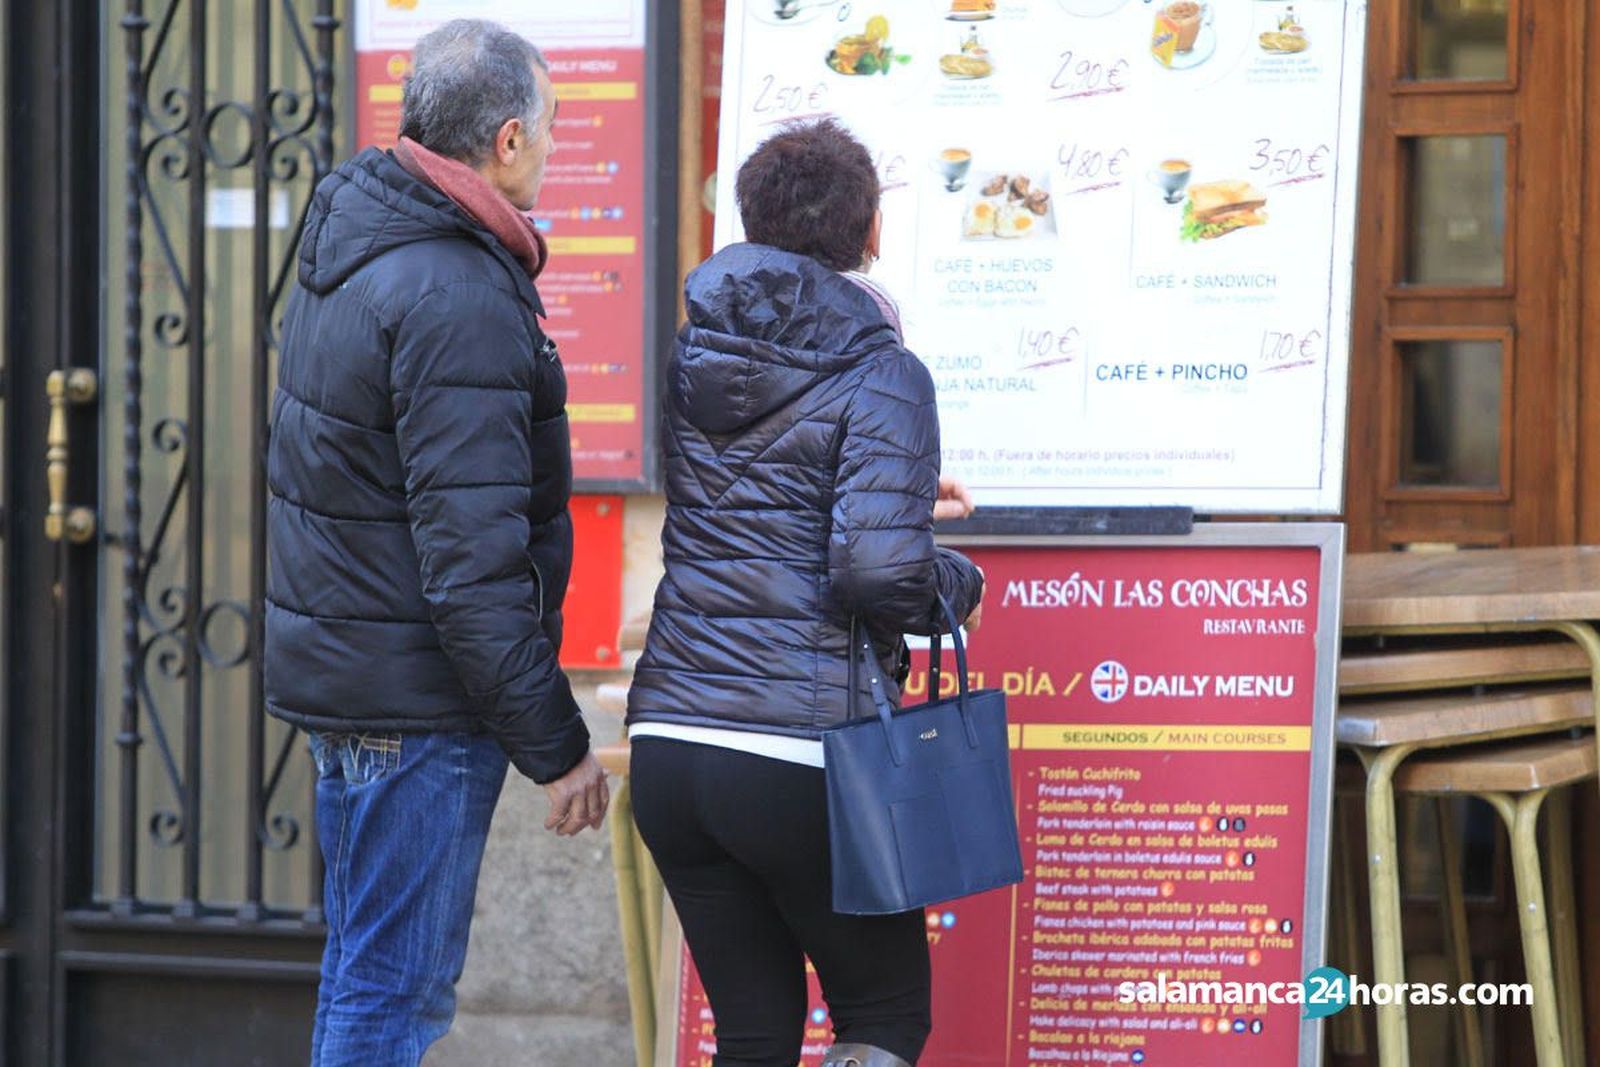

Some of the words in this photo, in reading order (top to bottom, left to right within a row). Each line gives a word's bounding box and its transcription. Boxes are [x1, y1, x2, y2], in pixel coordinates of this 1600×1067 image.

[990, 257, 1053, 273] HUEVOS
[947, 279, 981, 293] CON
[984, 279, 1039, 293] BACON
[1193, 273, 1277, 288] SANDWICH
[935, 355, 982, 370] ZUMO
[1096, 361, 1148, 381] CAFÉ
[1172, 363, 1249, 381] PINCHO
[964, 377, 1040, 392] NATURAL
[1036, 449, 1051, 461] de
[1055, 449, 1101, 461] horario
[1104, 450, 1150, 463] precios
[1154, 449, 1236, 464] individuales)
[1001, 572, 1105, 607] MESÓN
[1113, 579, 1164, 607] LAS
[1170, 579, 1309, 608] CONCHAS
[1002, 665, 1057, 697] DÍA
[1062, 672, 1084, 696] /
[1133, 676, 1211, 697] DAILY
[1215, 675, 1294, 697] MENU
[1063, 731, 1148, 744] SEGUNDOS
[1168, 731, 1208, 744] MAIN
[1213, 732, 1287, 745] COURSES
[1038, 783, 1066, 796] Fried
[1091, 800, 1107, 813] de
[1111, 801, 1146, 814] Cerdo
[1149, 803, 1170, 814] con
[1173, 801, 1203, 815] salsa
[1206, 801, 1221, 815] de
[1225, 804, 1251, 815] uvas
[1255, 804, 1288, 819] pasas
[1113, 818, 1136, 831] with
[1167, 820, 1196, 832] sauce
[1036, 832, 1066, 845] Lomo
[1069, 833, 1085, 846] de
[1088, 832, 1123, 846] Cerdo
[1126, 836, 1141, 847] en
[1145, 833, 1175, 847] salsa
[1178, 834, 1193, 848] de
[1197, 834, 1240, 848] boletus
[1193, 853, 1222, 865] sauce
[1075, 866, 1090, 879] de
[1094, 867, 1139, 879] ternera
[1185, 869, 1206, 881] con
[1209, 868, 1255, 884] patatas
[1035, 882, 1060, 895] Beef
[1090, 884, 1113, 896] with
[1114, 884, 1158, 898] potatoes
[1073, 899, 1088, 912] de
[1092, 899, 1119, 915] pollo
[1123, 902, 1144, 913] con
[1147, 901, 1192, 916] patatas
[1208, 900, 1238, 915] salsa
[1241, 904, 1268, 915] rosa
[1106, 917, 1129, 929] with
[1130, 918, 1173, 931] potatoes
[1175, 918, 1194, 930] and
[1217, 920, 1246, 932] sauce
[1185, 936, 1206, 947] con
[1209, 935, 1255, 950] patatas
[1259, 934, 1294, 949] fritas
[1159, 951, 1181, 963] with
[1183, 951, 1217, 965] french
[1084, 964, 1100, 978] de
[1103, 966, 1149, 979] cordero
[1090, 984, 1113, 996] with
[1072, 998, 1088, 1011] de
[1098, 1016, 1120, 1028] with
[1150, 1018, 1168, 1030] and
[1088, 1031, 1101, 1046] la
